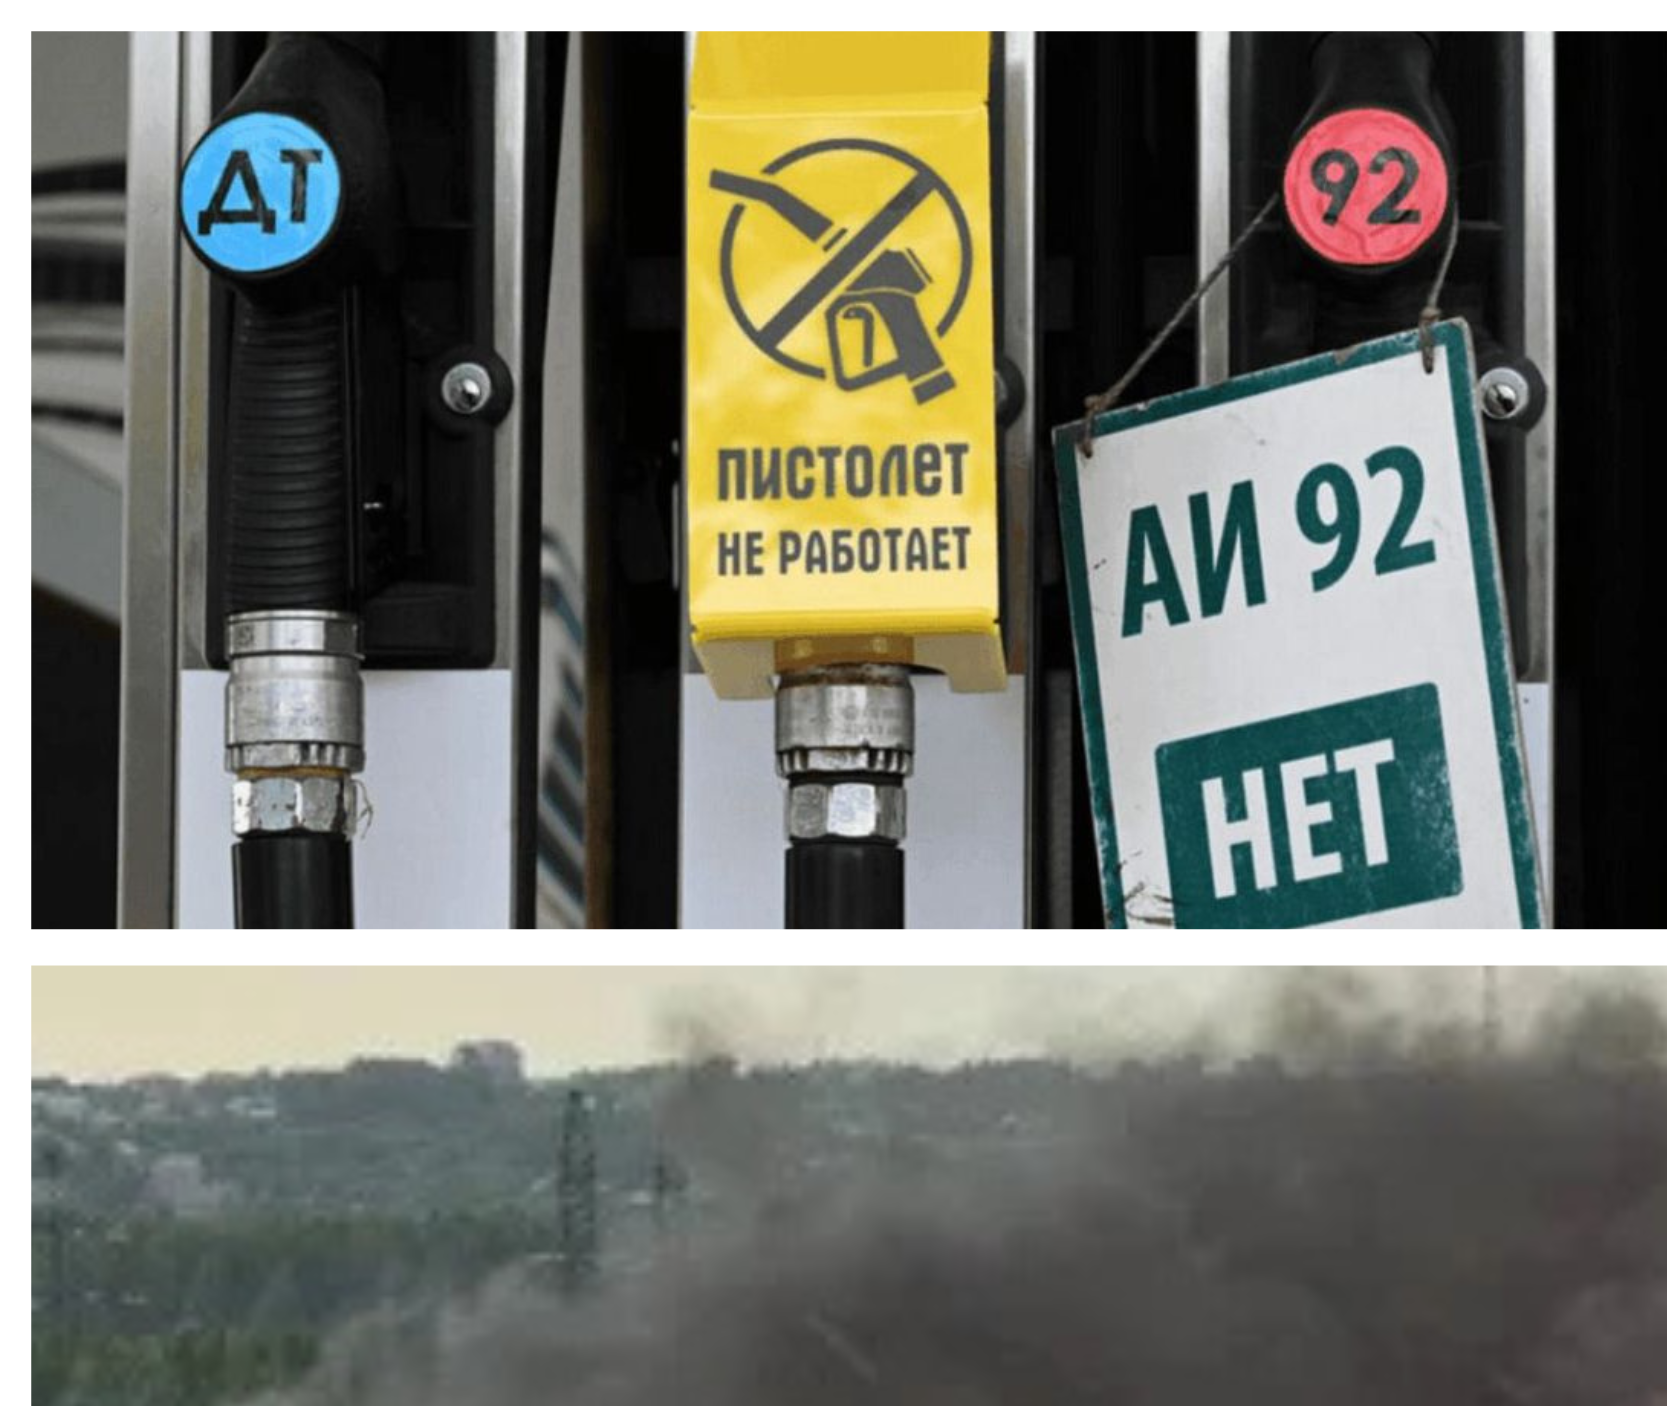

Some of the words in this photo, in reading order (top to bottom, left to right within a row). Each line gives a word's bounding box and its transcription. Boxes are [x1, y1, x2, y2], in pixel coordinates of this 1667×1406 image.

[198, 149, 323, 235] ДТ
[1309, 147, 1421, 225] 92
[717, 532, 764, 577] НЕ
[778, 525, 971, 575] РАБОТАЕТ
[1121, 480, 1266, 638] АИ
[1295, 445, 1436, 592] 92
[1202, 738, 1395, 899] НЕТ
